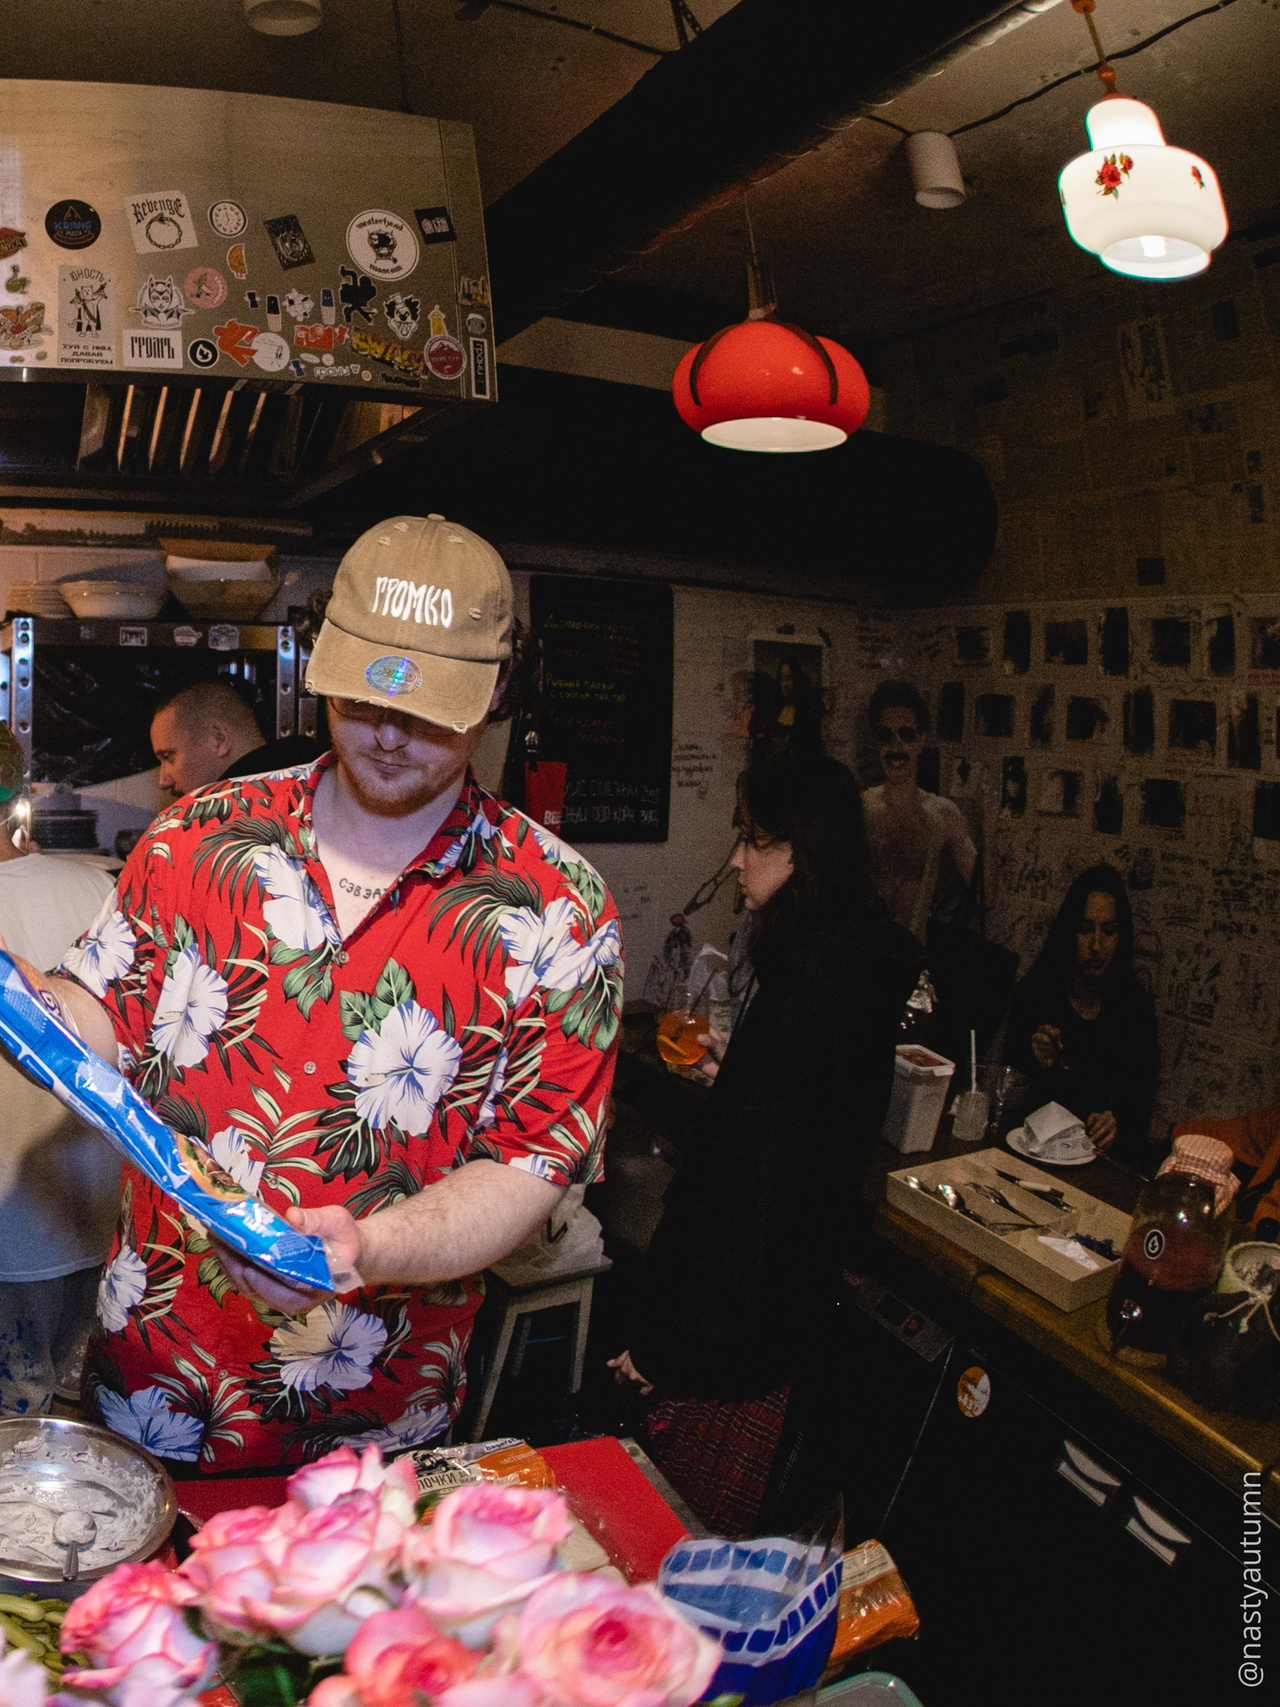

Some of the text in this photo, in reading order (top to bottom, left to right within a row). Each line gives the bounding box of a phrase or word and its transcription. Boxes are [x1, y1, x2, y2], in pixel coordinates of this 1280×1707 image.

[70, 268, 105, 283] ЮНОСТЬ
[60, 357, 114, 365] ПОПРОБУЕМ
[371, 575, 454, 629] ГРОМКО
